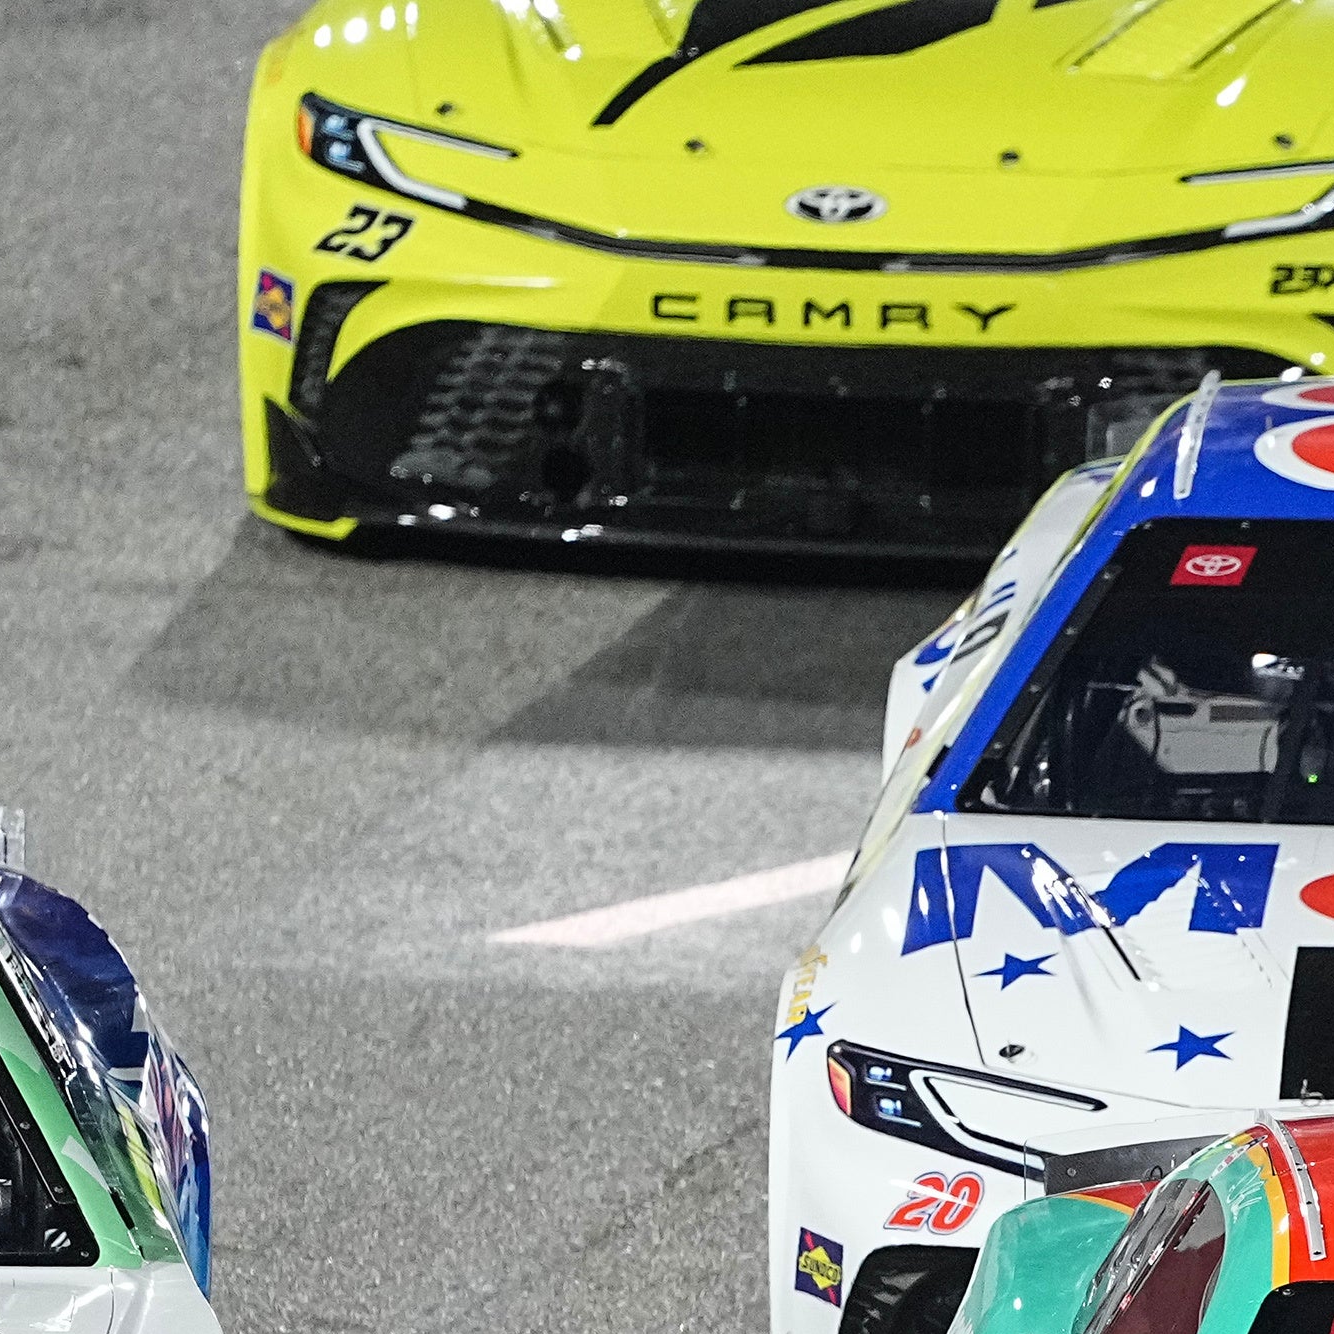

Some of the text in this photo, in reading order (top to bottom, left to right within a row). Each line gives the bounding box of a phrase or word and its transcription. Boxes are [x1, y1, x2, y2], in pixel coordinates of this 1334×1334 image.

[313, 205, 415, 262] 23
[650, 292, 1016, 332] CAMRY
[884, 1171, 986, 1235] 20
